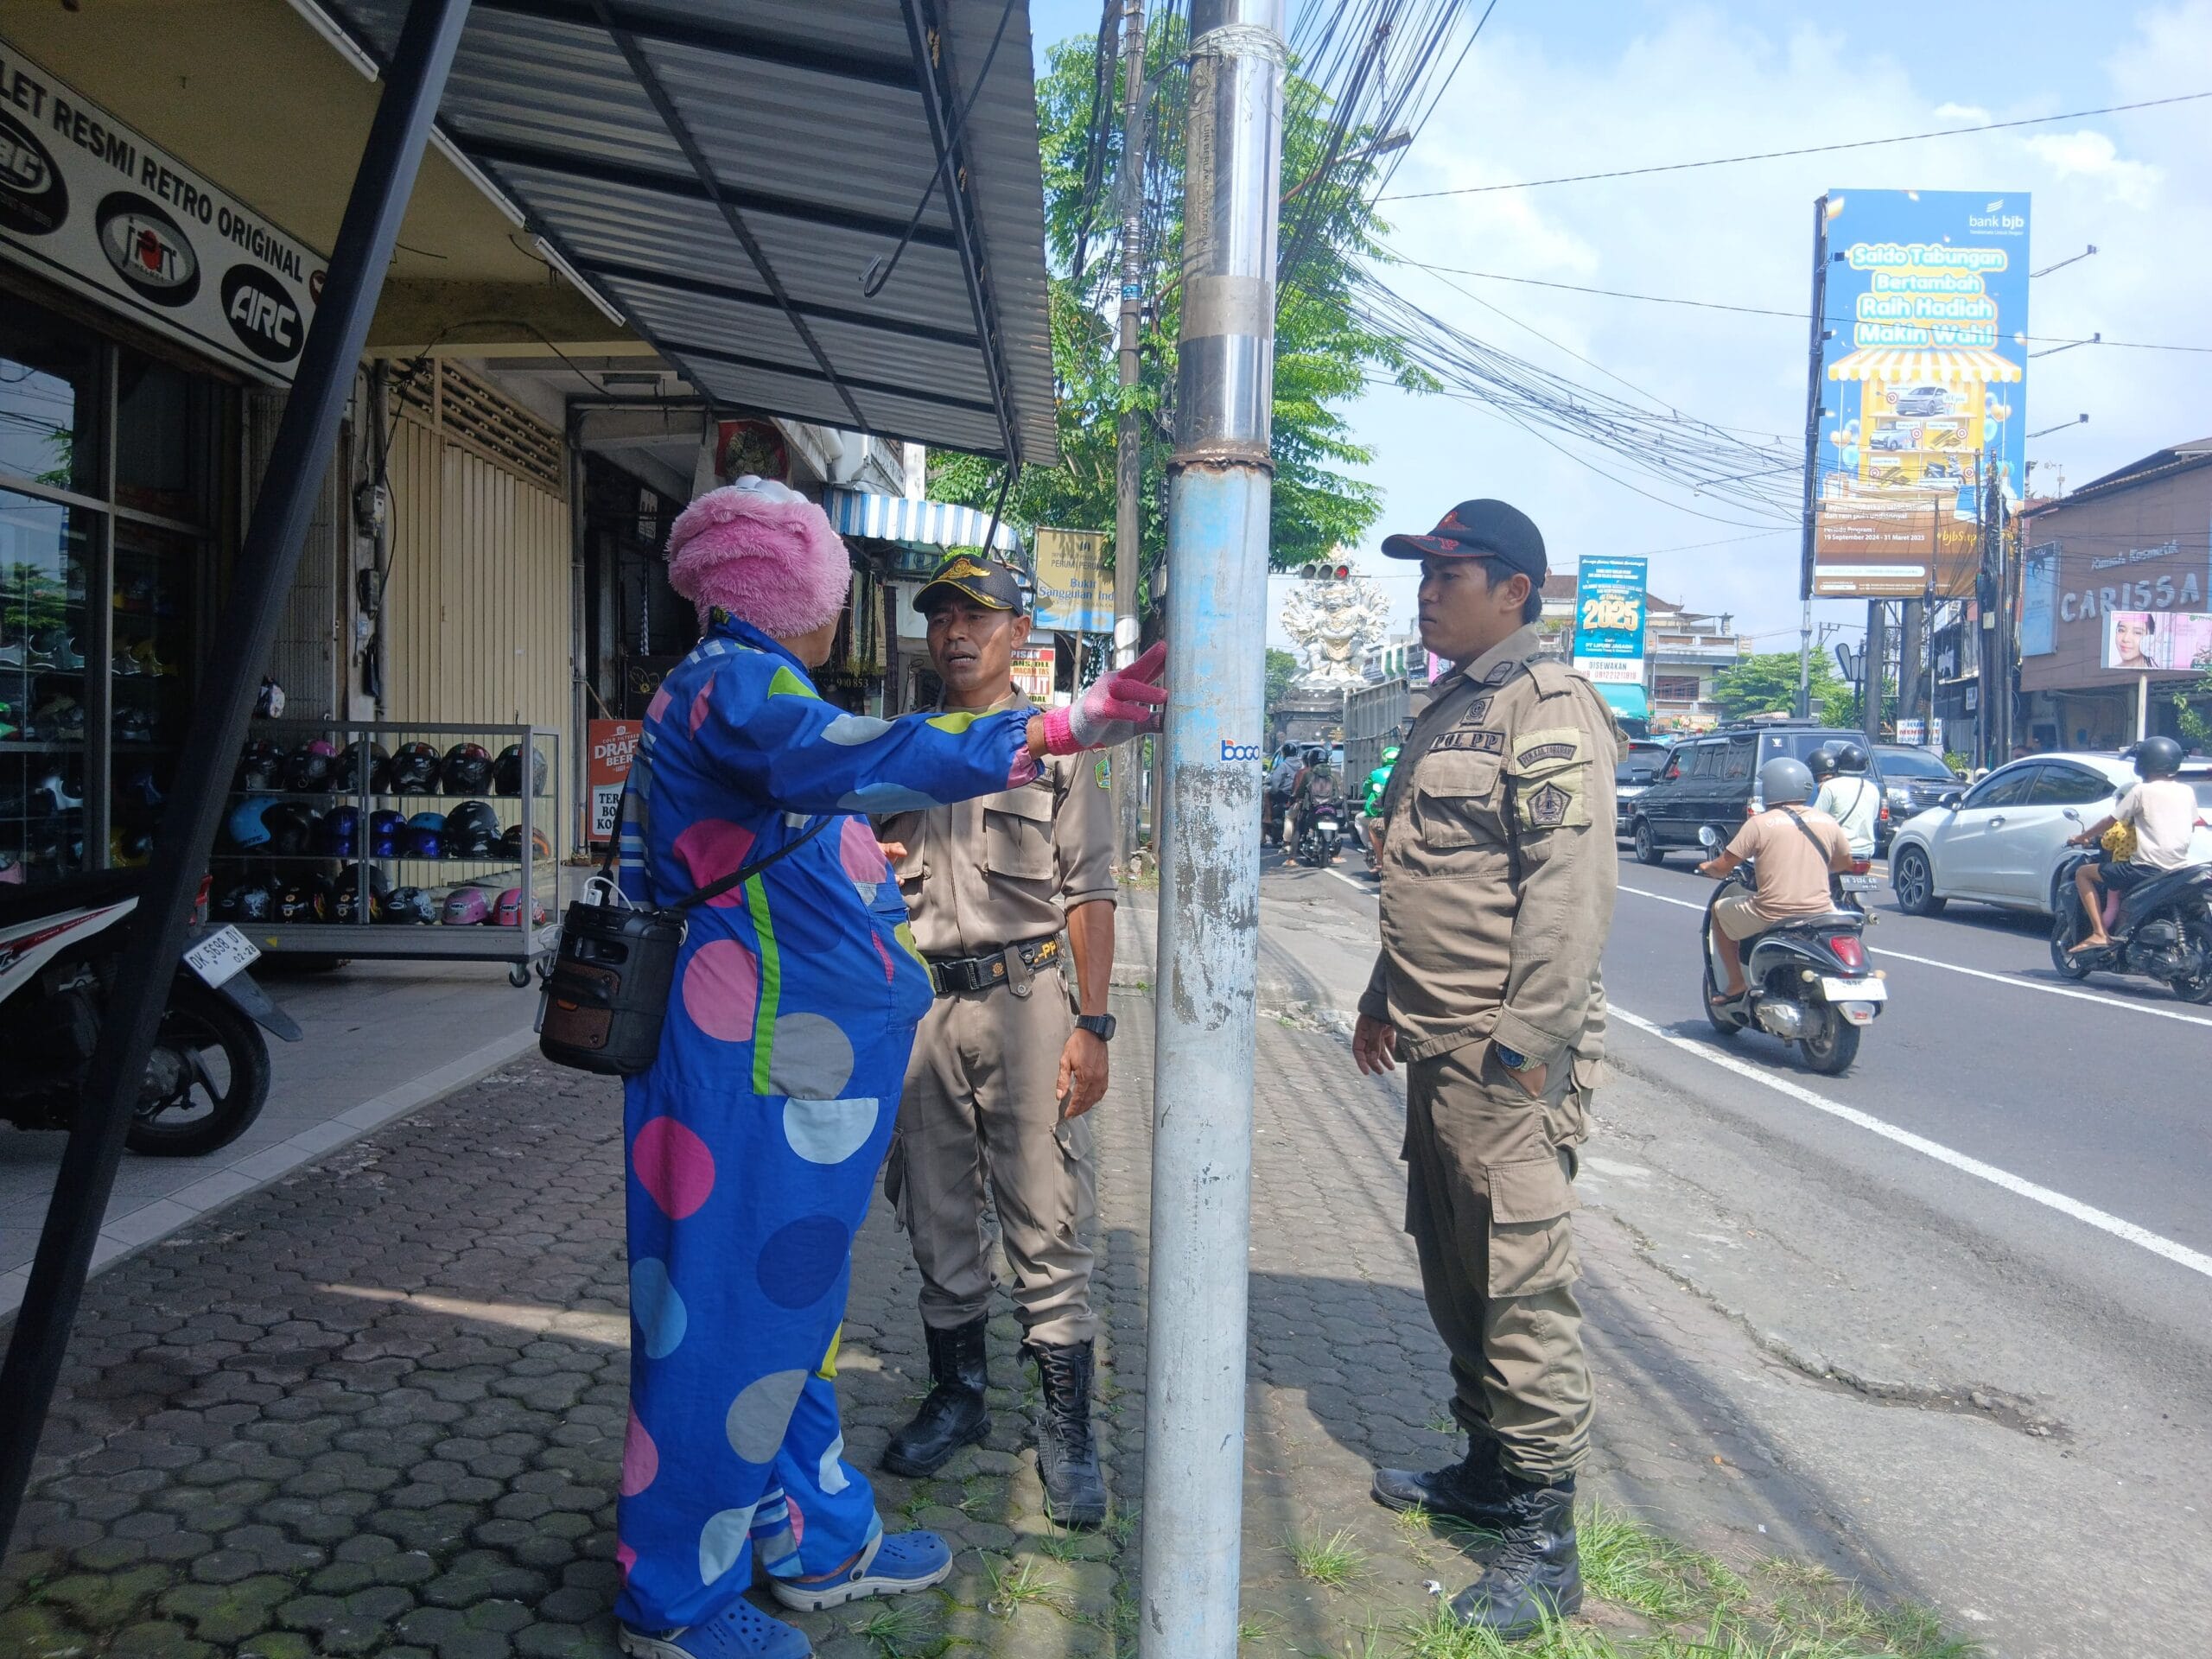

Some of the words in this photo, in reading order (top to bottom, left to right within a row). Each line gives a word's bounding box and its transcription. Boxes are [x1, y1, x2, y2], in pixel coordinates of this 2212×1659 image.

[53, 97, 137, 179] RESMI
[141, 155, 213, 226] RETRO
[218, 207, 303, 284] ORIGINAL
[1969, 215, 1999, 227] bank
[2002, 215, 2024, 230] bjb
[1853, 247, 1908, 266] Saldo
[1910, 247, 2004, 268] Tabungan
[1876, 273, 1980, 292] Bertambah
[230, 284, 296, 348] ARC
[1861, 296, 1912, 318] Raih
[1915, 297, 1993, 320] Hadiah
[1859, 322, 1928, 344] Makin
[1070, 577, 1096, 588] Bukit
[1039, 586, 1093, 601] Sanggulan
[1098, 590, 1115, 601] Ind
[2061, 573, 2201, 623] CARISSA
[1582, 600, 1641, 632] 2025
[1010, 649, 1040, 659] PISAN
[1588, 661, 1628, 671] DISEWAKAN
[1013, 676, 1050, 695] KULIT
[594, 739, 639, 760] DRAF
[1433, 734, 1464, 750] POL
[1469, 734, 1499, 750] PP
[607, 753, 633, 767] BEER
[598, 792, 620, 804] TER
[601, 805, 616, 817] BO
[596, 818, 613, 830] KO
[189, 951, 210, 969] DK
[203, 938, 230, 959] 5698
